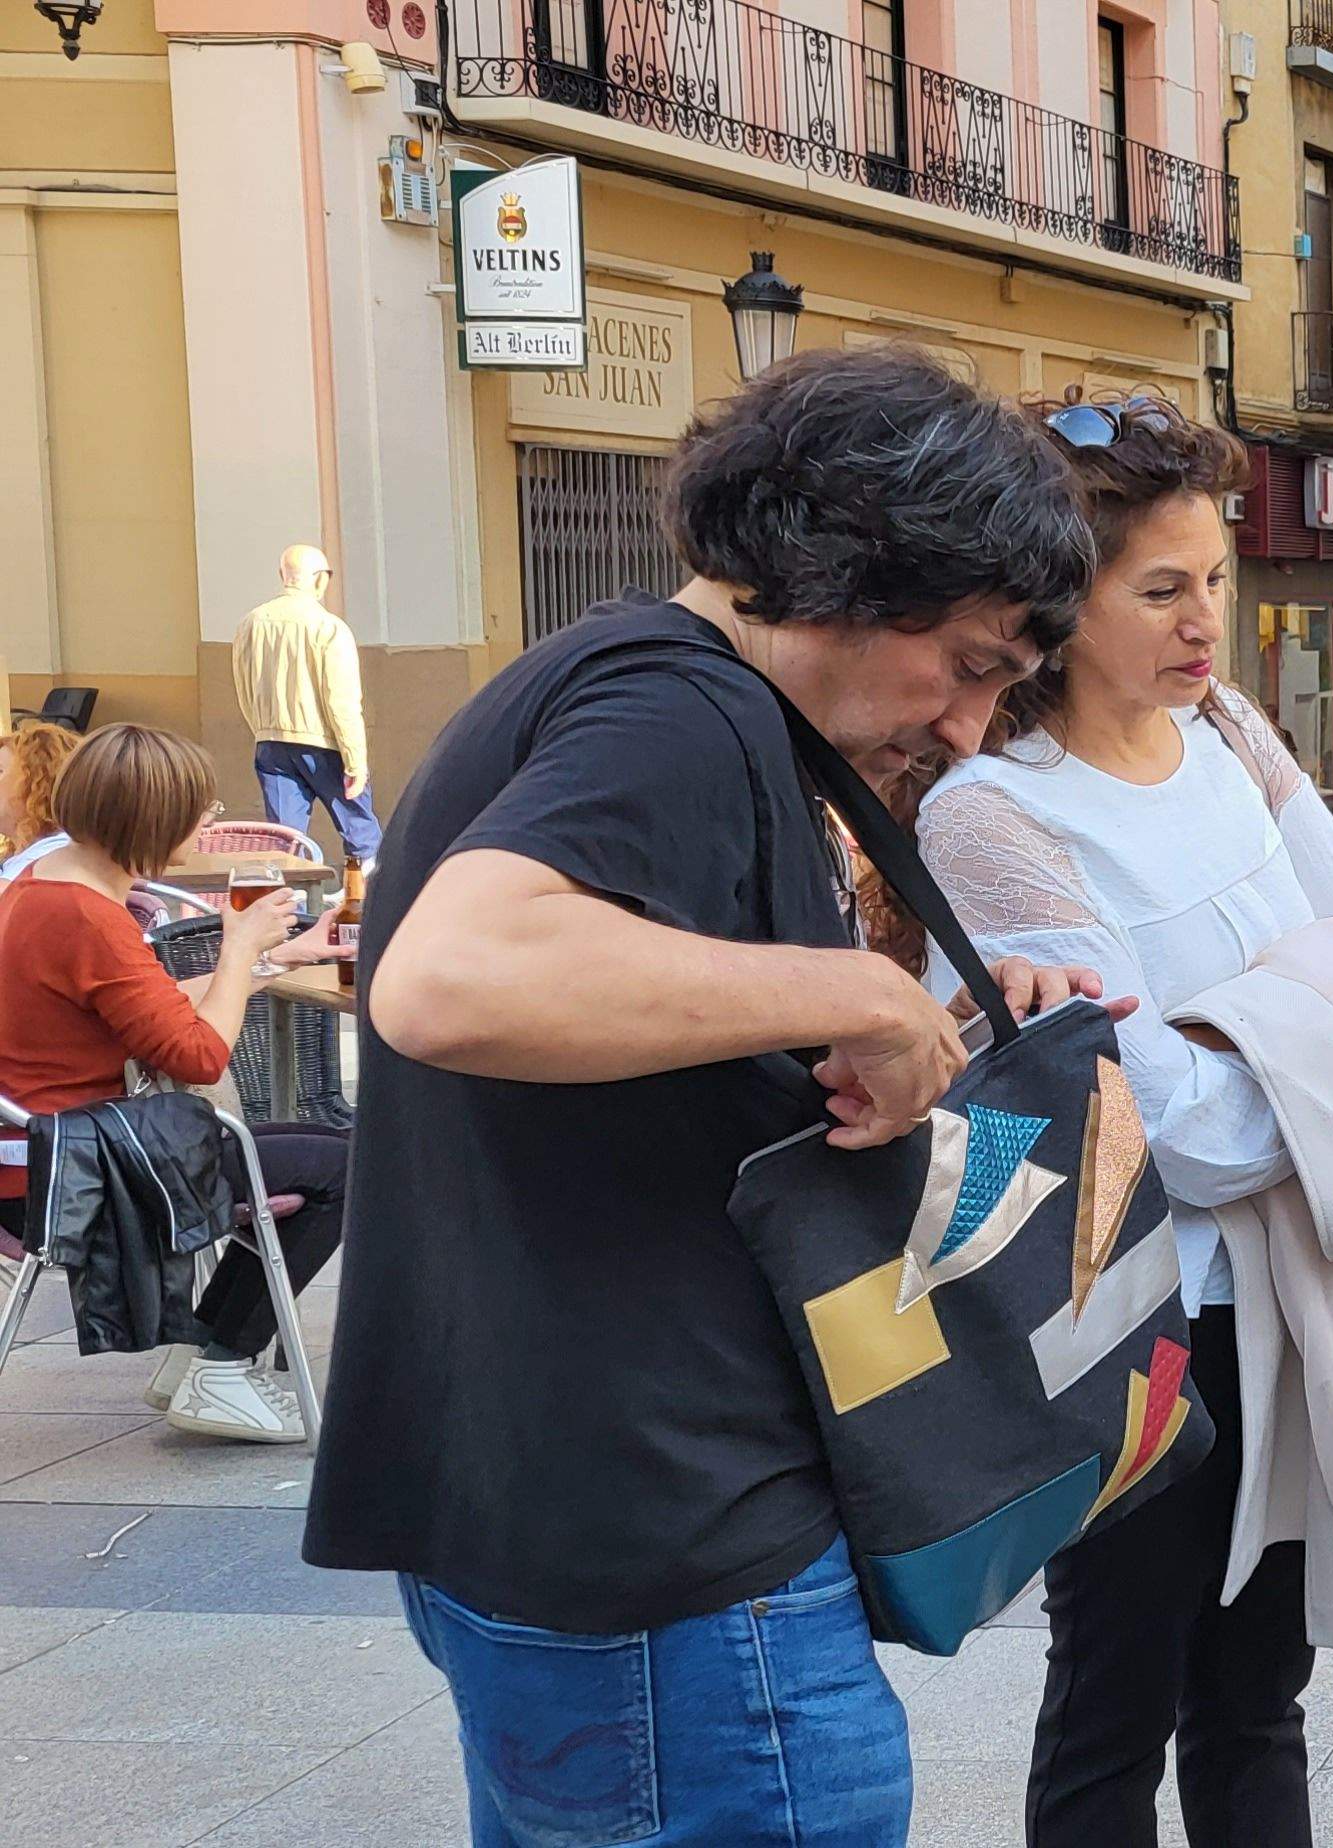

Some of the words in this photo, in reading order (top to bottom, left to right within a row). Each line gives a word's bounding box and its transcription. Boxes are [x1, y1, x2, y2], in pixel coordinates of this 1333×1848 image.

[472, 248, 562, 272] VELTINS
[473, 331, 500, 354] Alt
[587, 315, 672, 364] ACENES
[543, 371, 591, 399] SAN
[599, 364, 663, 408] JUAN
